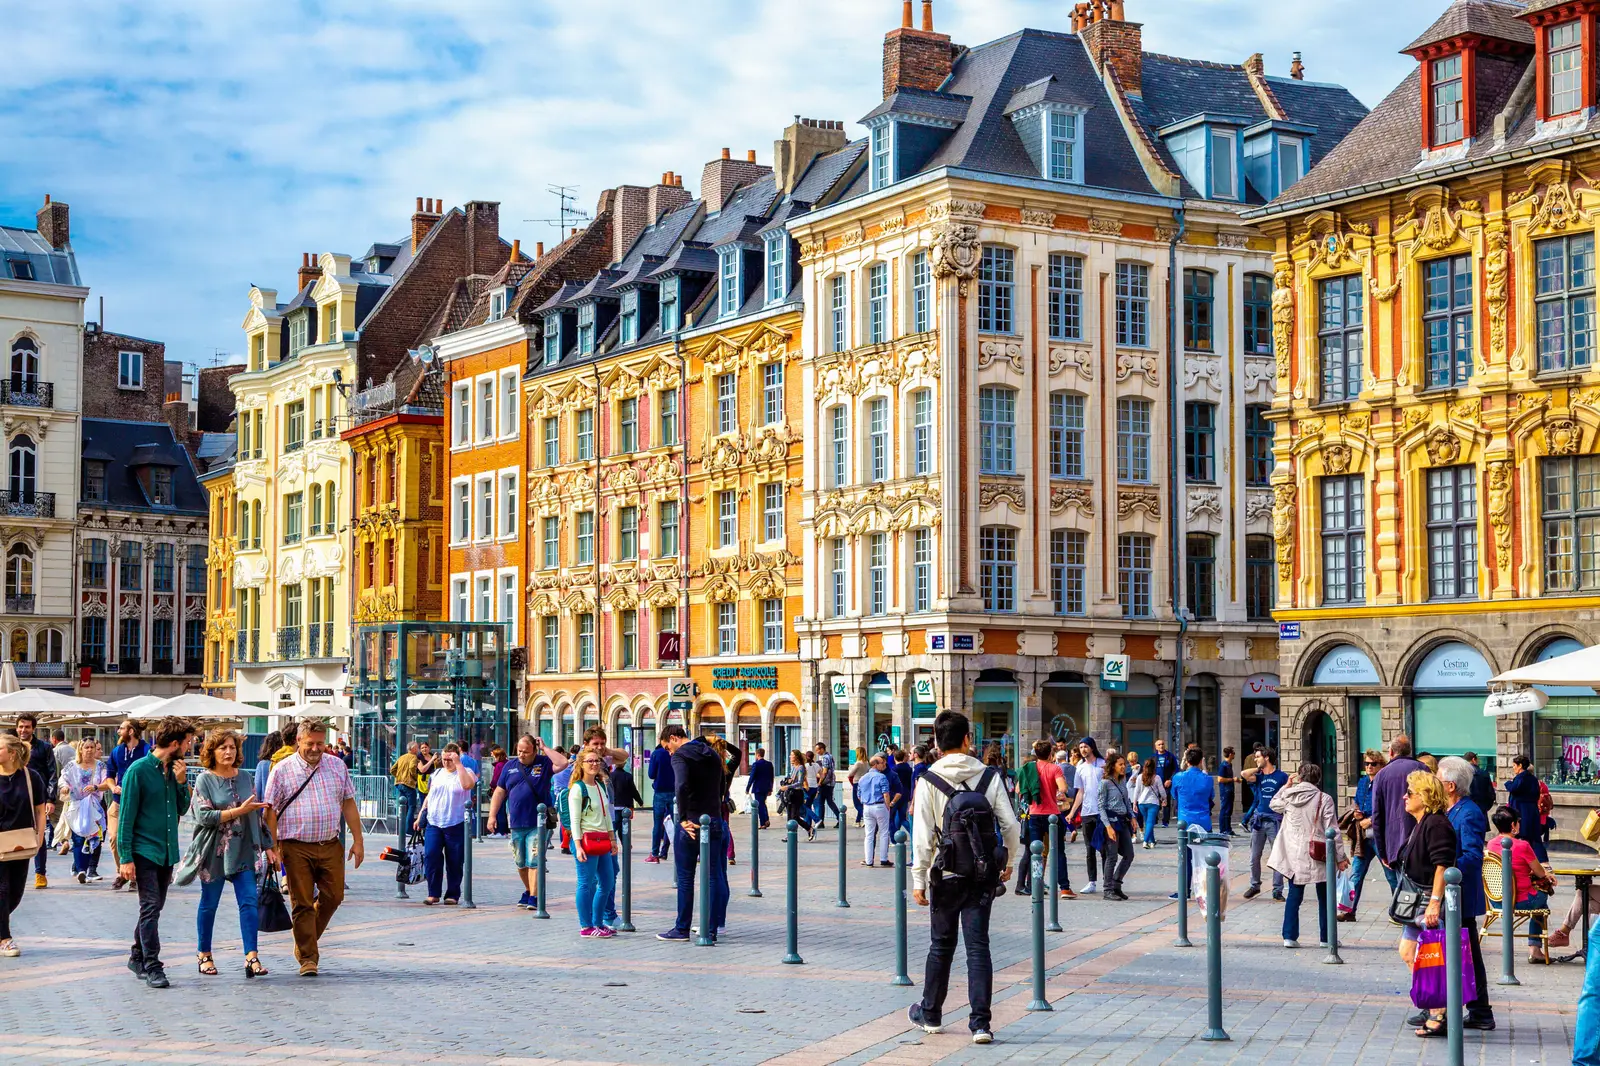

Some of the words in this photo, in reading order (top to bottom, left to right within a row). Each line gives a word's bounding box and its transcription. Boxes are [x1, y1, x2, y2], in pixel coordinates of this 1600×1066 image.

[1336, 656, 1360, 667] Cestino
[1443, 658, 1469, 669] Cestino
[740, 666, 776, 677] AGRICOLE
[1457, 670, 1476, 678] vintage
[712, 679, 733, 689] NORD
[734, 679, 745, 689] DE
[746, 678, 776, 689] FRANCE
